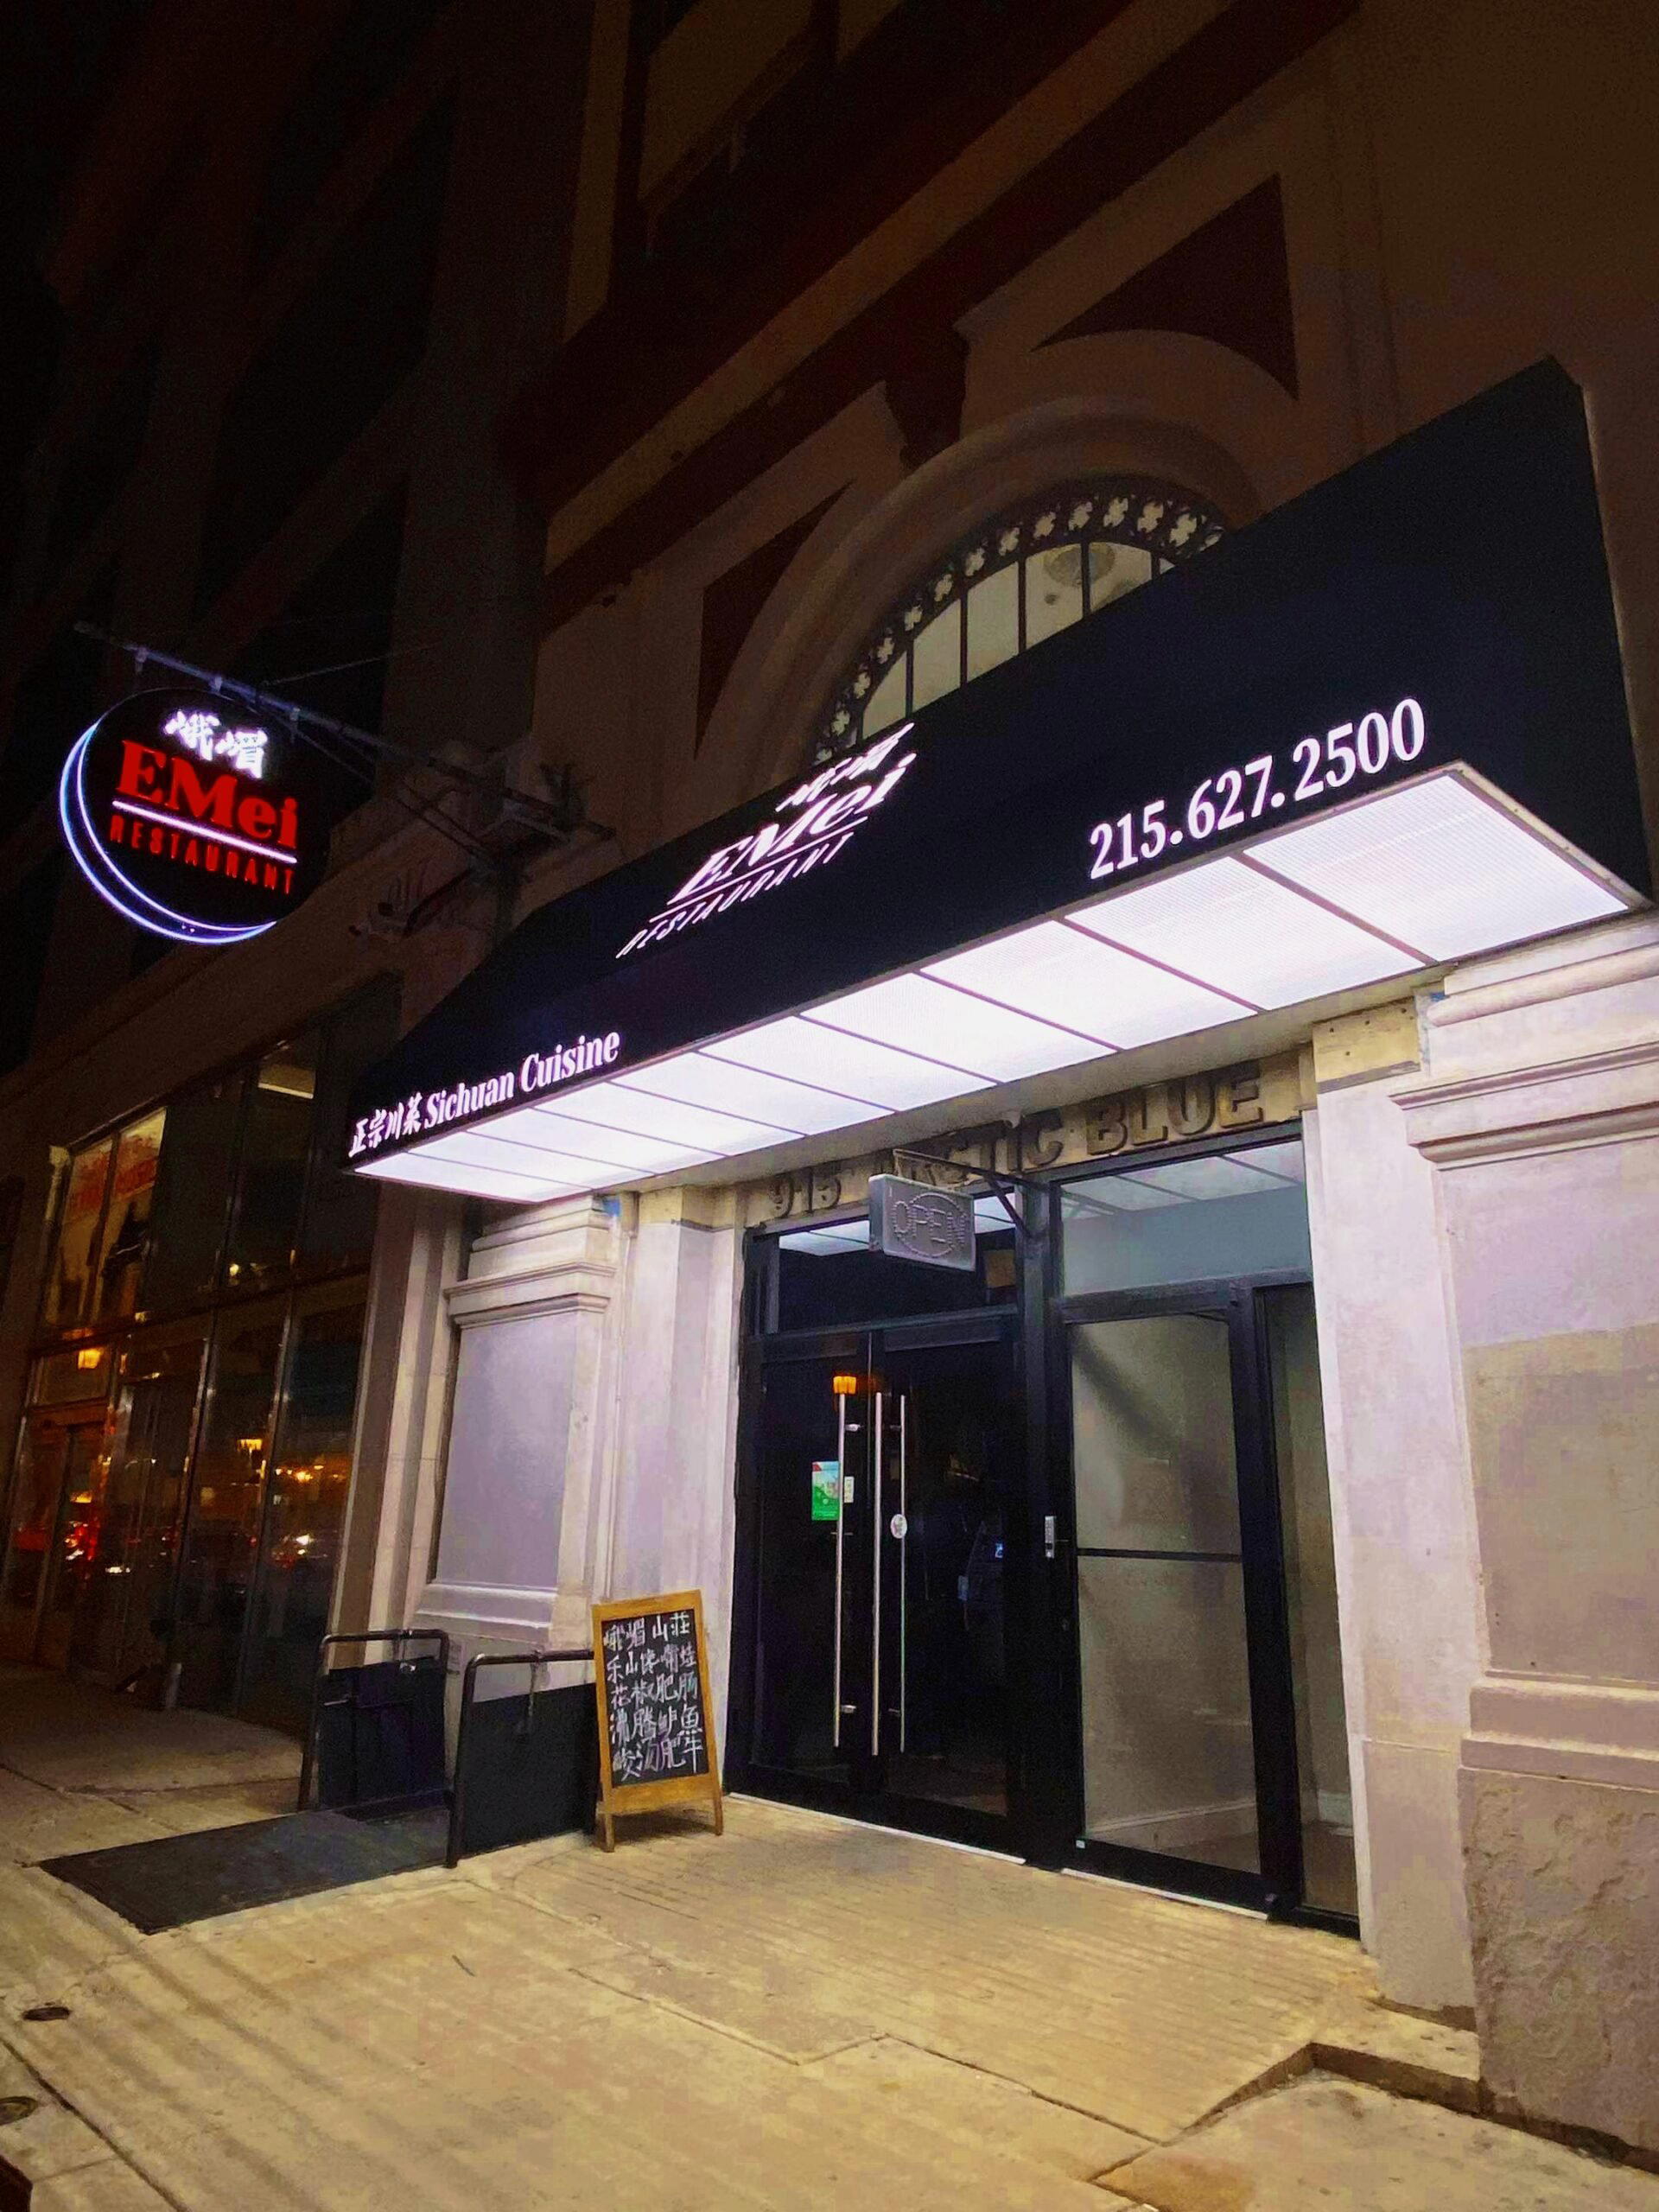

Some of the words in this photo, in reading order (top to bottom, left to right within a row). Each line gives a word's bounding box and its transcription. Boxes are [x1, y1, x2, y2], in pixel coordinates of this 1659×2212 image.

[115, 740, 299, 849] EMei
[666, 753, 917, 906] EMei
[1089, 697, 1426, 880] 215.627.2500
[109, 814, 295, 895] RESTAURANT
[615, 831, 855, 959] RESTAURANT
[348, 1092, 423, 1159] 正宗川菜
[424, 1071, 515, 1129] Sichuan
[520, 1032, 620, 1093] Cuisine
[1084, 1061, 1265, 1156] BLUE
